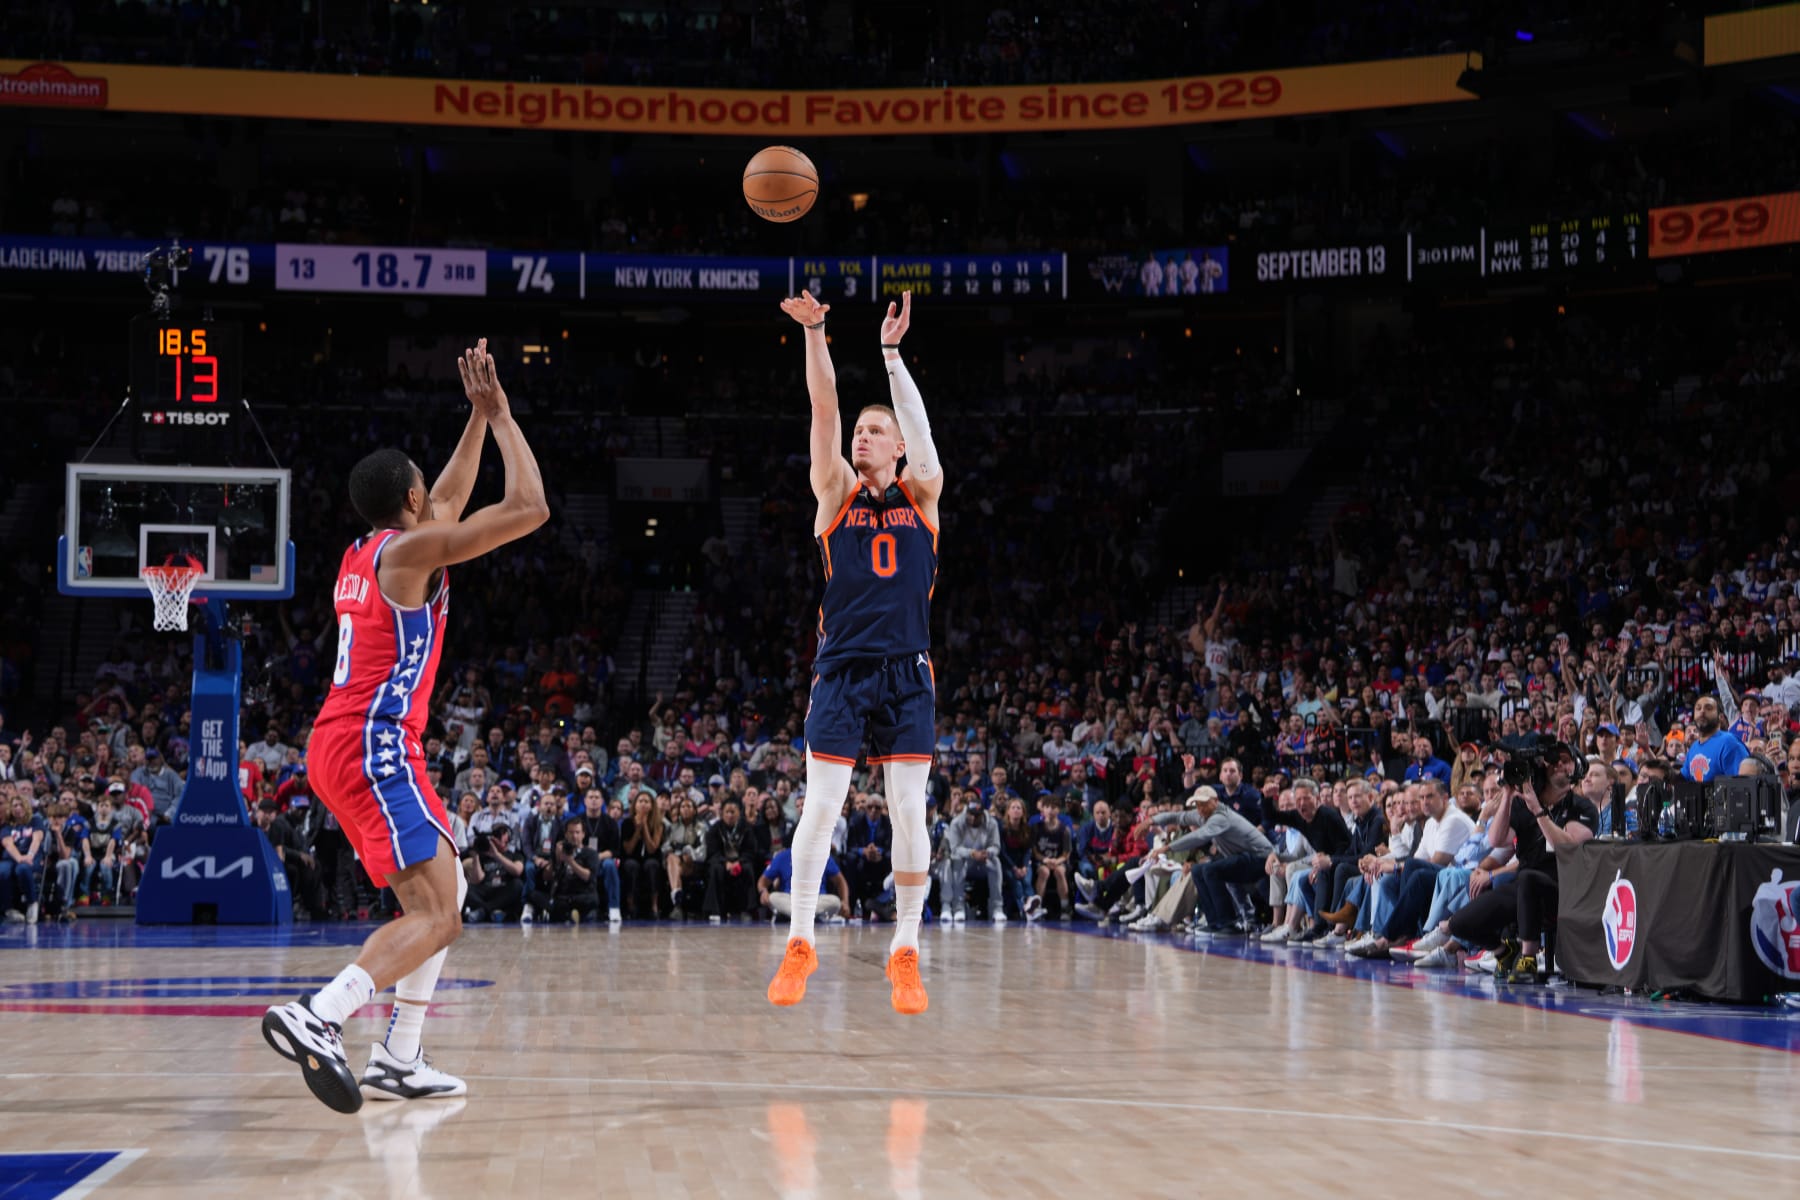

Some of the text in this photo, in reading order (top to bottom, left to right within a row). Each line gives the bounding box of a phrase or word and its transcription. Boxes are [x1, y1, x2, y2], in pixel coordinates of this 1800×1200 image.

[434, 75, 1284, 127] Neighborhood Favorite since 1929
[1494, 238, 1519, 256] PHI
[1560, 231, 1580, 251] 20
[203, 246, 250, 285] 76
[289, 252, 476, 289] 13 18.7 3RD
[803, 261, 863, 276] FLS TOL
[882, 263, 932, 278] PLAYER
[1016, 261, 1029, 276] 11
[1257, 244, 1386, 281] SEPTEMBER 13
[1491, 254, 1522, 274] NYK
[1563, 250, 1579, 267] 16
[512, 256, 555, 293] 74
[614, 267, 760, 290] NEW YORK KNICKS
[844, 277, 857, 297] 3
[882, 280, 932, 296] POINTS
[965, 279, 979, 295] 12
[159, 328, 207, 356] 18.5
[175, 356, 218, 402] 13
[166, 412, 230, 426] TISSOT
[844, 508, 879, 530] NEW
[871, 532, 899, 578] 0
[333, 612, 354, 687] 8
[202, 720, 224, 738] GET
[202, 738, 223, 757] THE
[206, 757, 228, 780] App
[179, 812, 238, 826] Google Pixel
[161, 855, 254, 879] KIA
